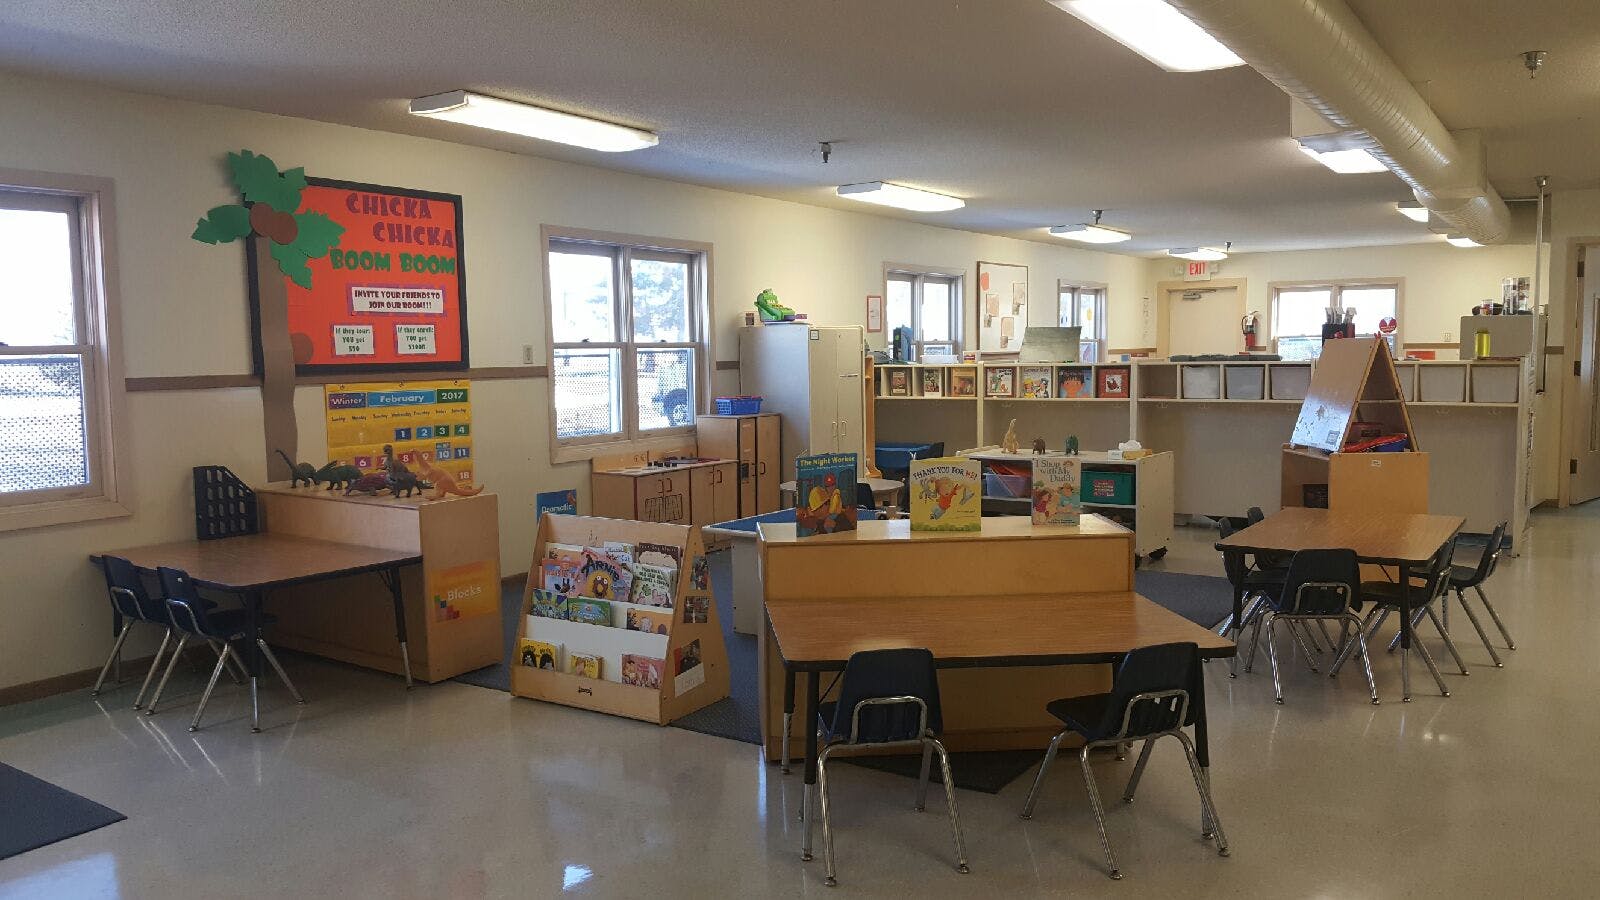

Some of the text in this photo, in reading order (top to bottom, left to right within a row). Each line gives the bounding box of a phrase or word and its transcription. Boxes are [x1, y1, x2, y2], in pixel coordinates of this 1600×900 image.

[347, 193, 431, 219] CHICKA
[372, 221, 454, 248] CHICKA
[330, 249, 456, 275] BOOM BOOM
[1189, 262, 1206, 275] EXIT
[354, 289, 440, 300] INVITE YOUR FRIENDS TO
[369, 301, 384, 309] JOIN
[386, 301, 401, 309] OUR
[332, 391, 464, 406] Winter February 2017
[400, 426, 465, 438] 1 2 3 4
[359, 458, 367, 467] 6
[402, 454, 409, 462] 8
[422, 452, 429, 460] 9
[438, 450, 450, 459] 10
[457, 448, 466, 456] 11
[813, 457, 831, 467] Night
[831, 455, 855, 464] Worker
[1040, 459, 1060, 469] Shop
[912, 466, 978, 481] THANK YOU FOR ME!
[1040, 466, 1071, 475] with My
[1050, 474, 1076, 482] Daddy
[541, 502, 573, 514] Dramatic
[447, 584, 482, 600] Blocks
